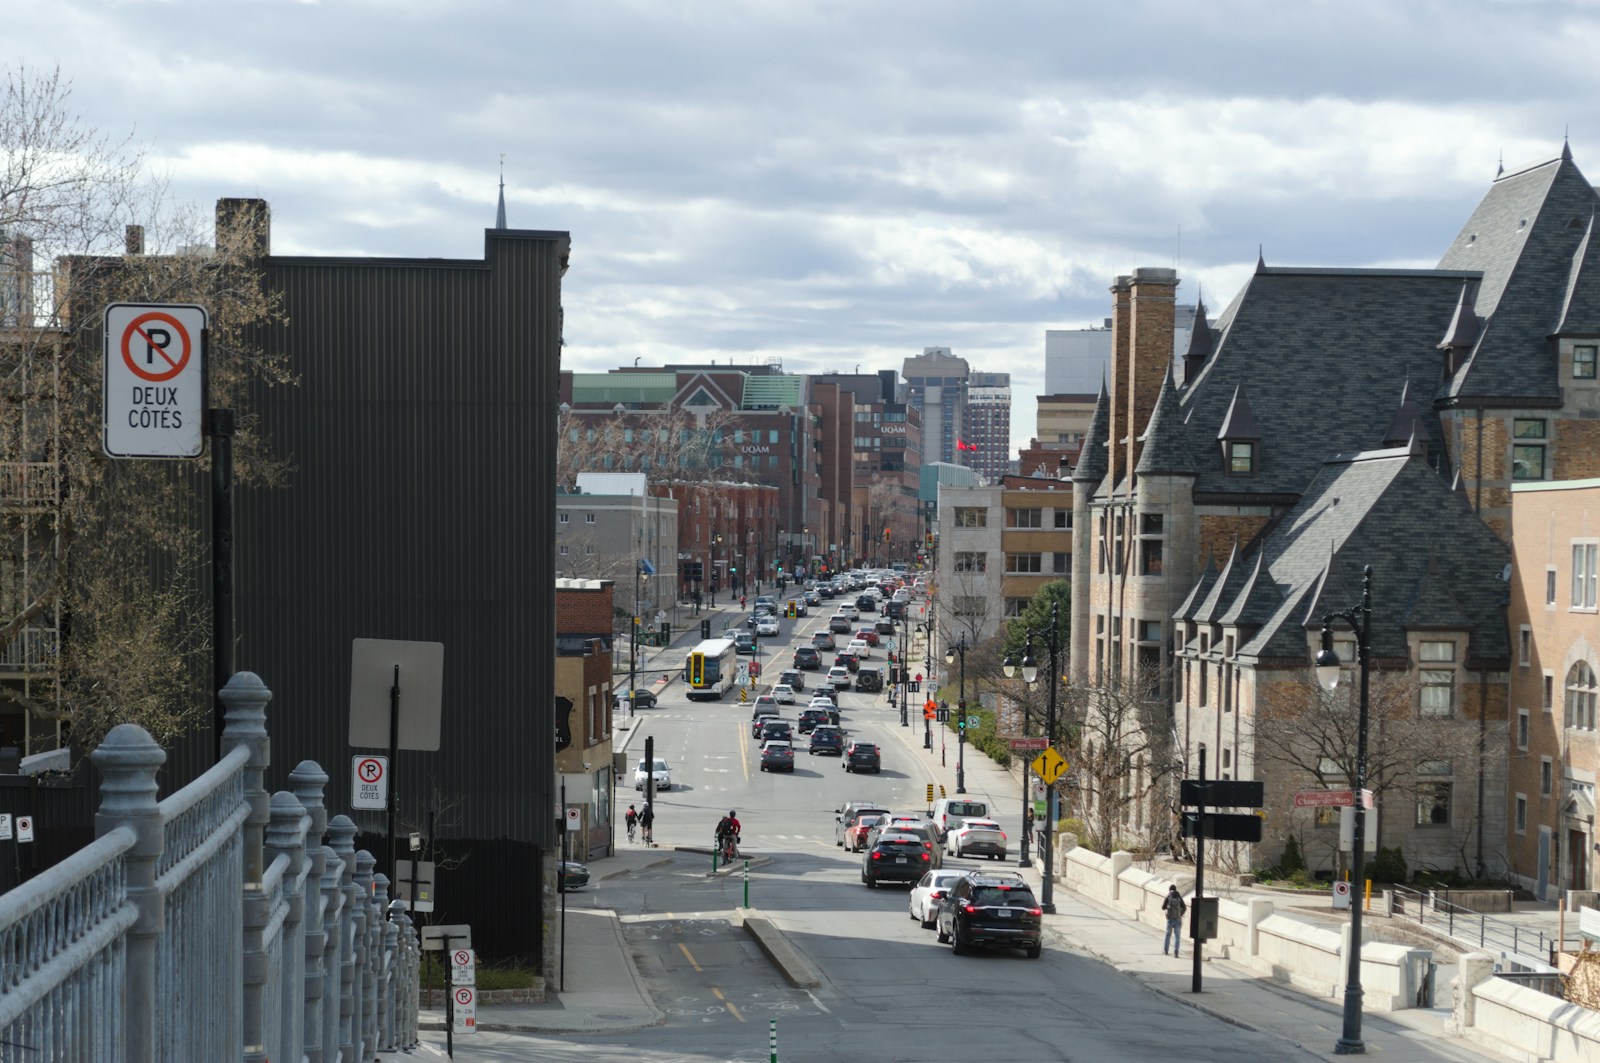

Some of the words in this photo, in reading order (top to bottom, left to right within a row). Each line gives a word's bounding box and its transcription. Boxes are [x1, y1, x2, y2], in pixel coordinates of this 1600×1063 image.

[132, 386, 178, 405] DEUX
[128, 407, 183, 429] CÔTÉS
[361, 784, 379, 792] DEUX
[359, 791, 380, 800] CÔTÉS
